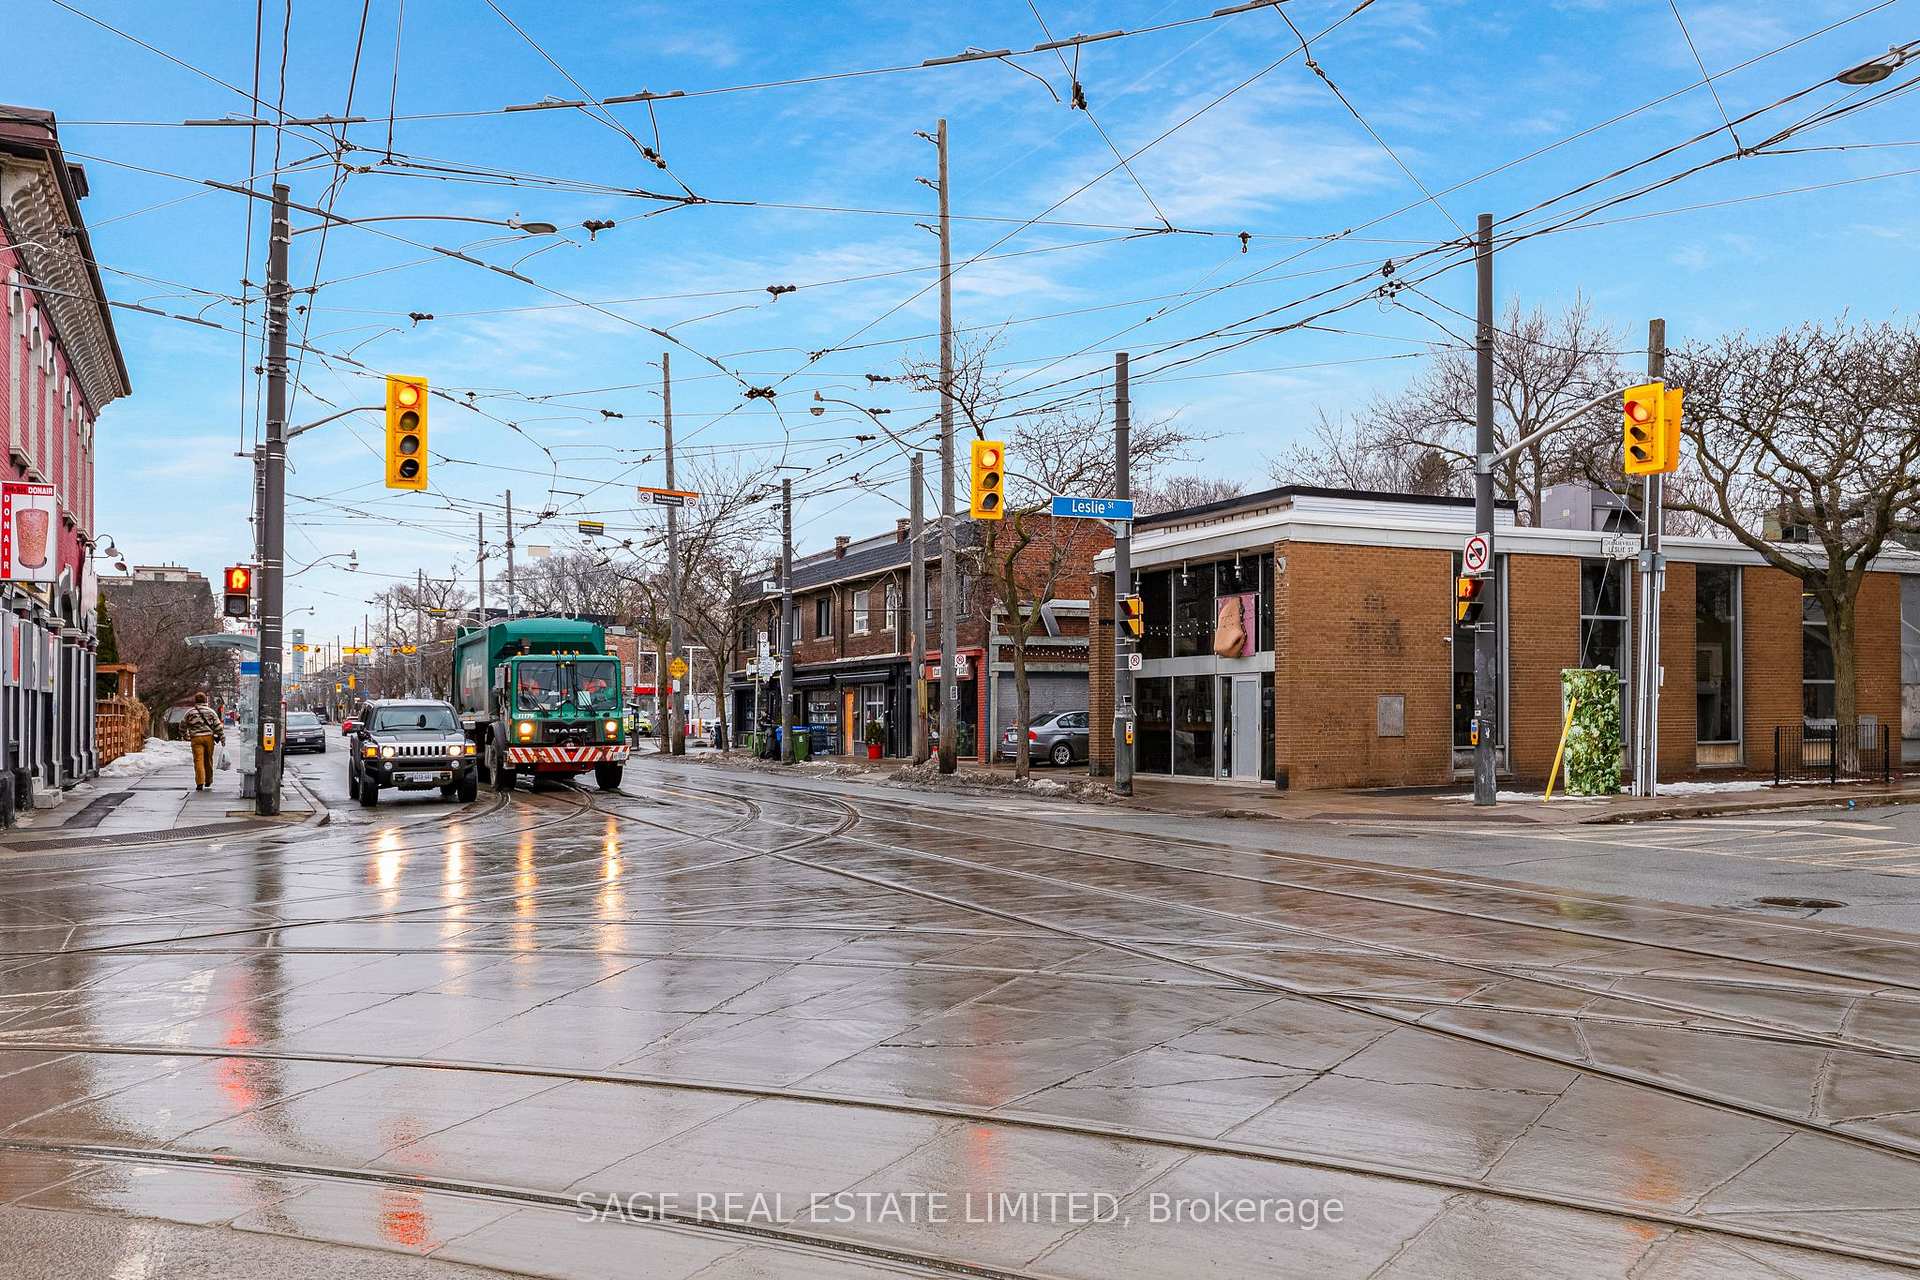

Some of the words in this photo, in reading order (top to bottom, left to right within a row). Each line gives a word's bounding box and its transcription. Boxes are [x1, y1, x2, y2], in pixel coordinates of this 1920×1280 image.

[28, 486, 53, 495] DONAIR
[1072, 500, 1105, 514] Leslie
[1107, 501, 1114, 509] St
